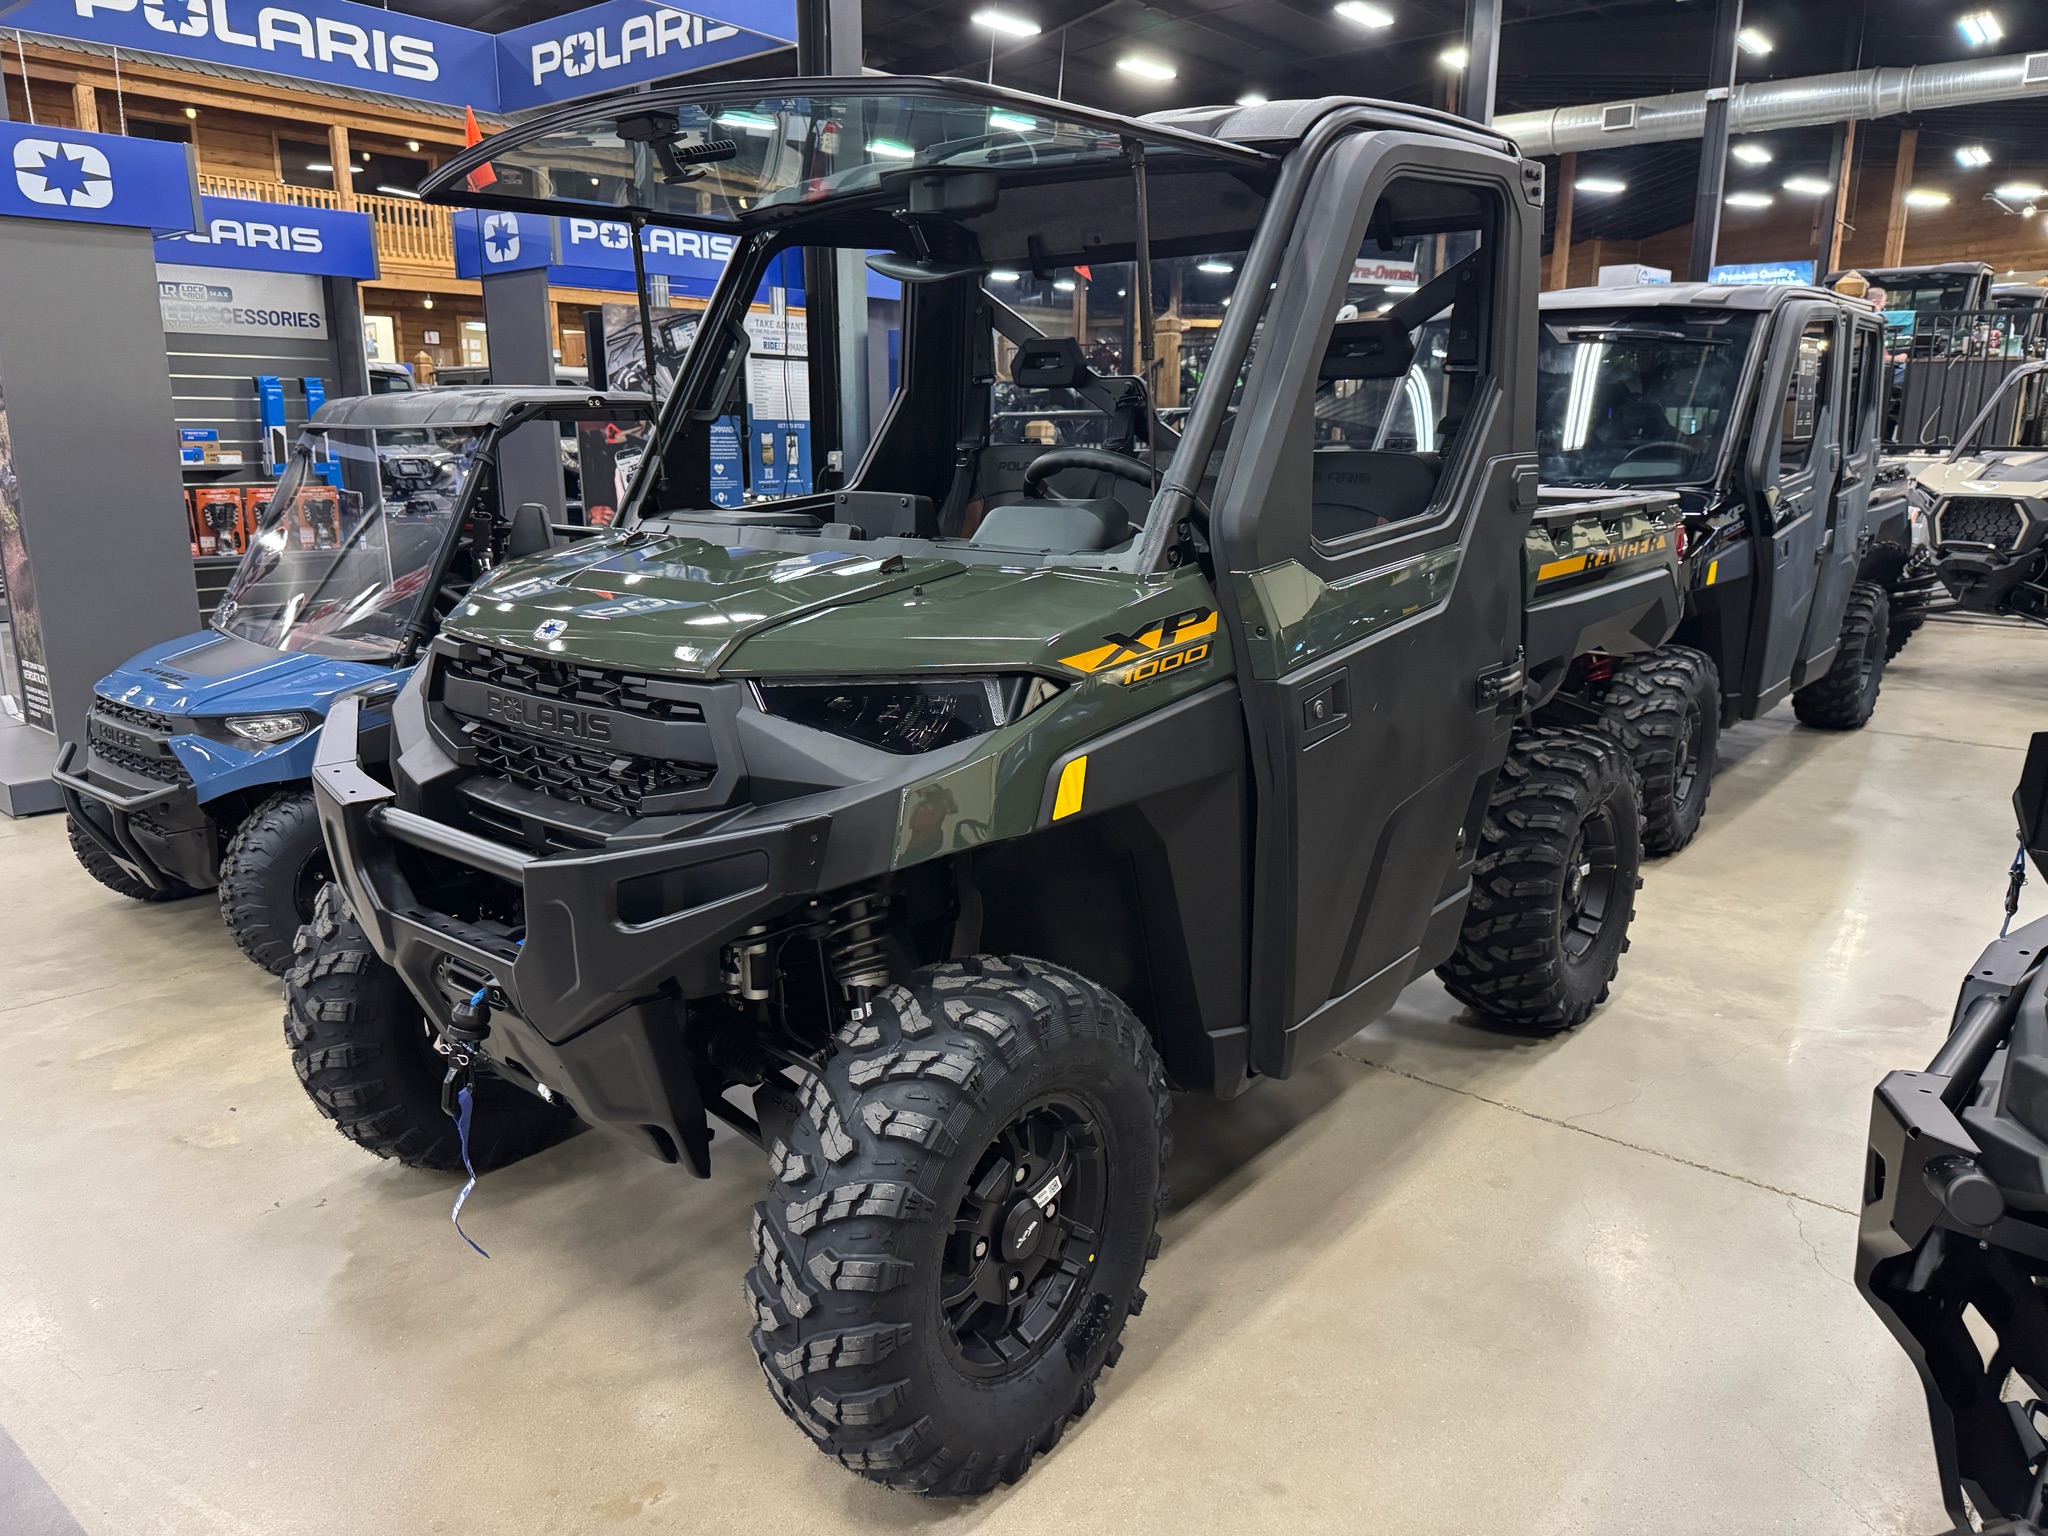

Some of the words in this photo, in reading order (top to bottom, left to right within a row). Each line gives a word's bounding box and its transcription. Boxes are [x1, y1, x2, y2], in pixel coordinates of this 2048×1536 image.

[169, 218, 323, 254] ARIS
[181, 284, 205, 294] LOCK
[209, 290, 229, 298] MAX
[193, 306, 321, 329] ACCESSORIES
[755, 318, 775, 329] TAKE
[776, 320, 808, 331] ADANT
[998, 461, 1031, 472] POLA
[1313, 471, 1373, 485] LARIS
[1092, 605, 1214, 671] XP
[1123, 643, 1209, 686] 1000
[486, 689, 613, 744] POLARIS
